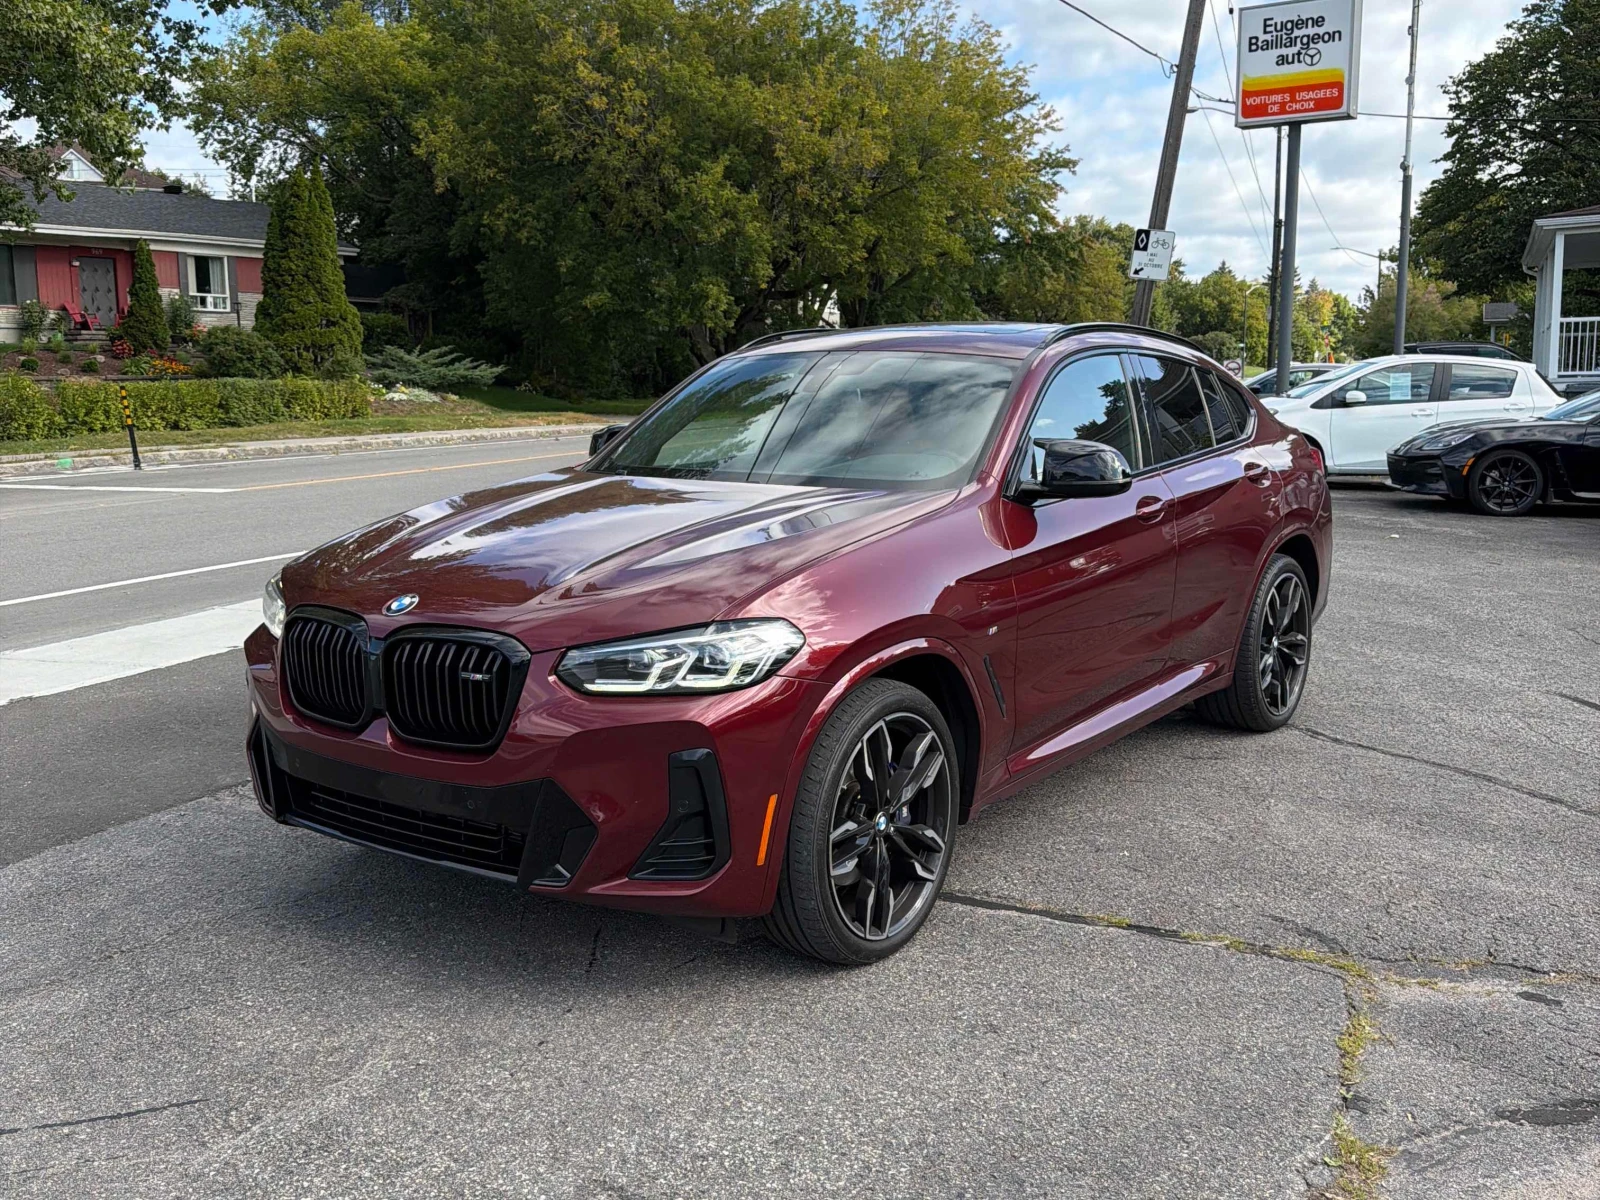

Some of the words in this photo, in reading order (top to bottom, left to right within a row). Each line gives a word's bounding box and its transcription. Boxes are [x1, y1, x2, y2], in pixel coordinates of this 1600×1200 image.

[1263, 15, 1325, 36] Eugène
[1248, 30, 1342, 52] Baillargeon
[1245, 93, 1290, 105] VOITURES
[1268, 105, 1280, 113] DE
[1286, 101, 1315, 111] CHOIX
